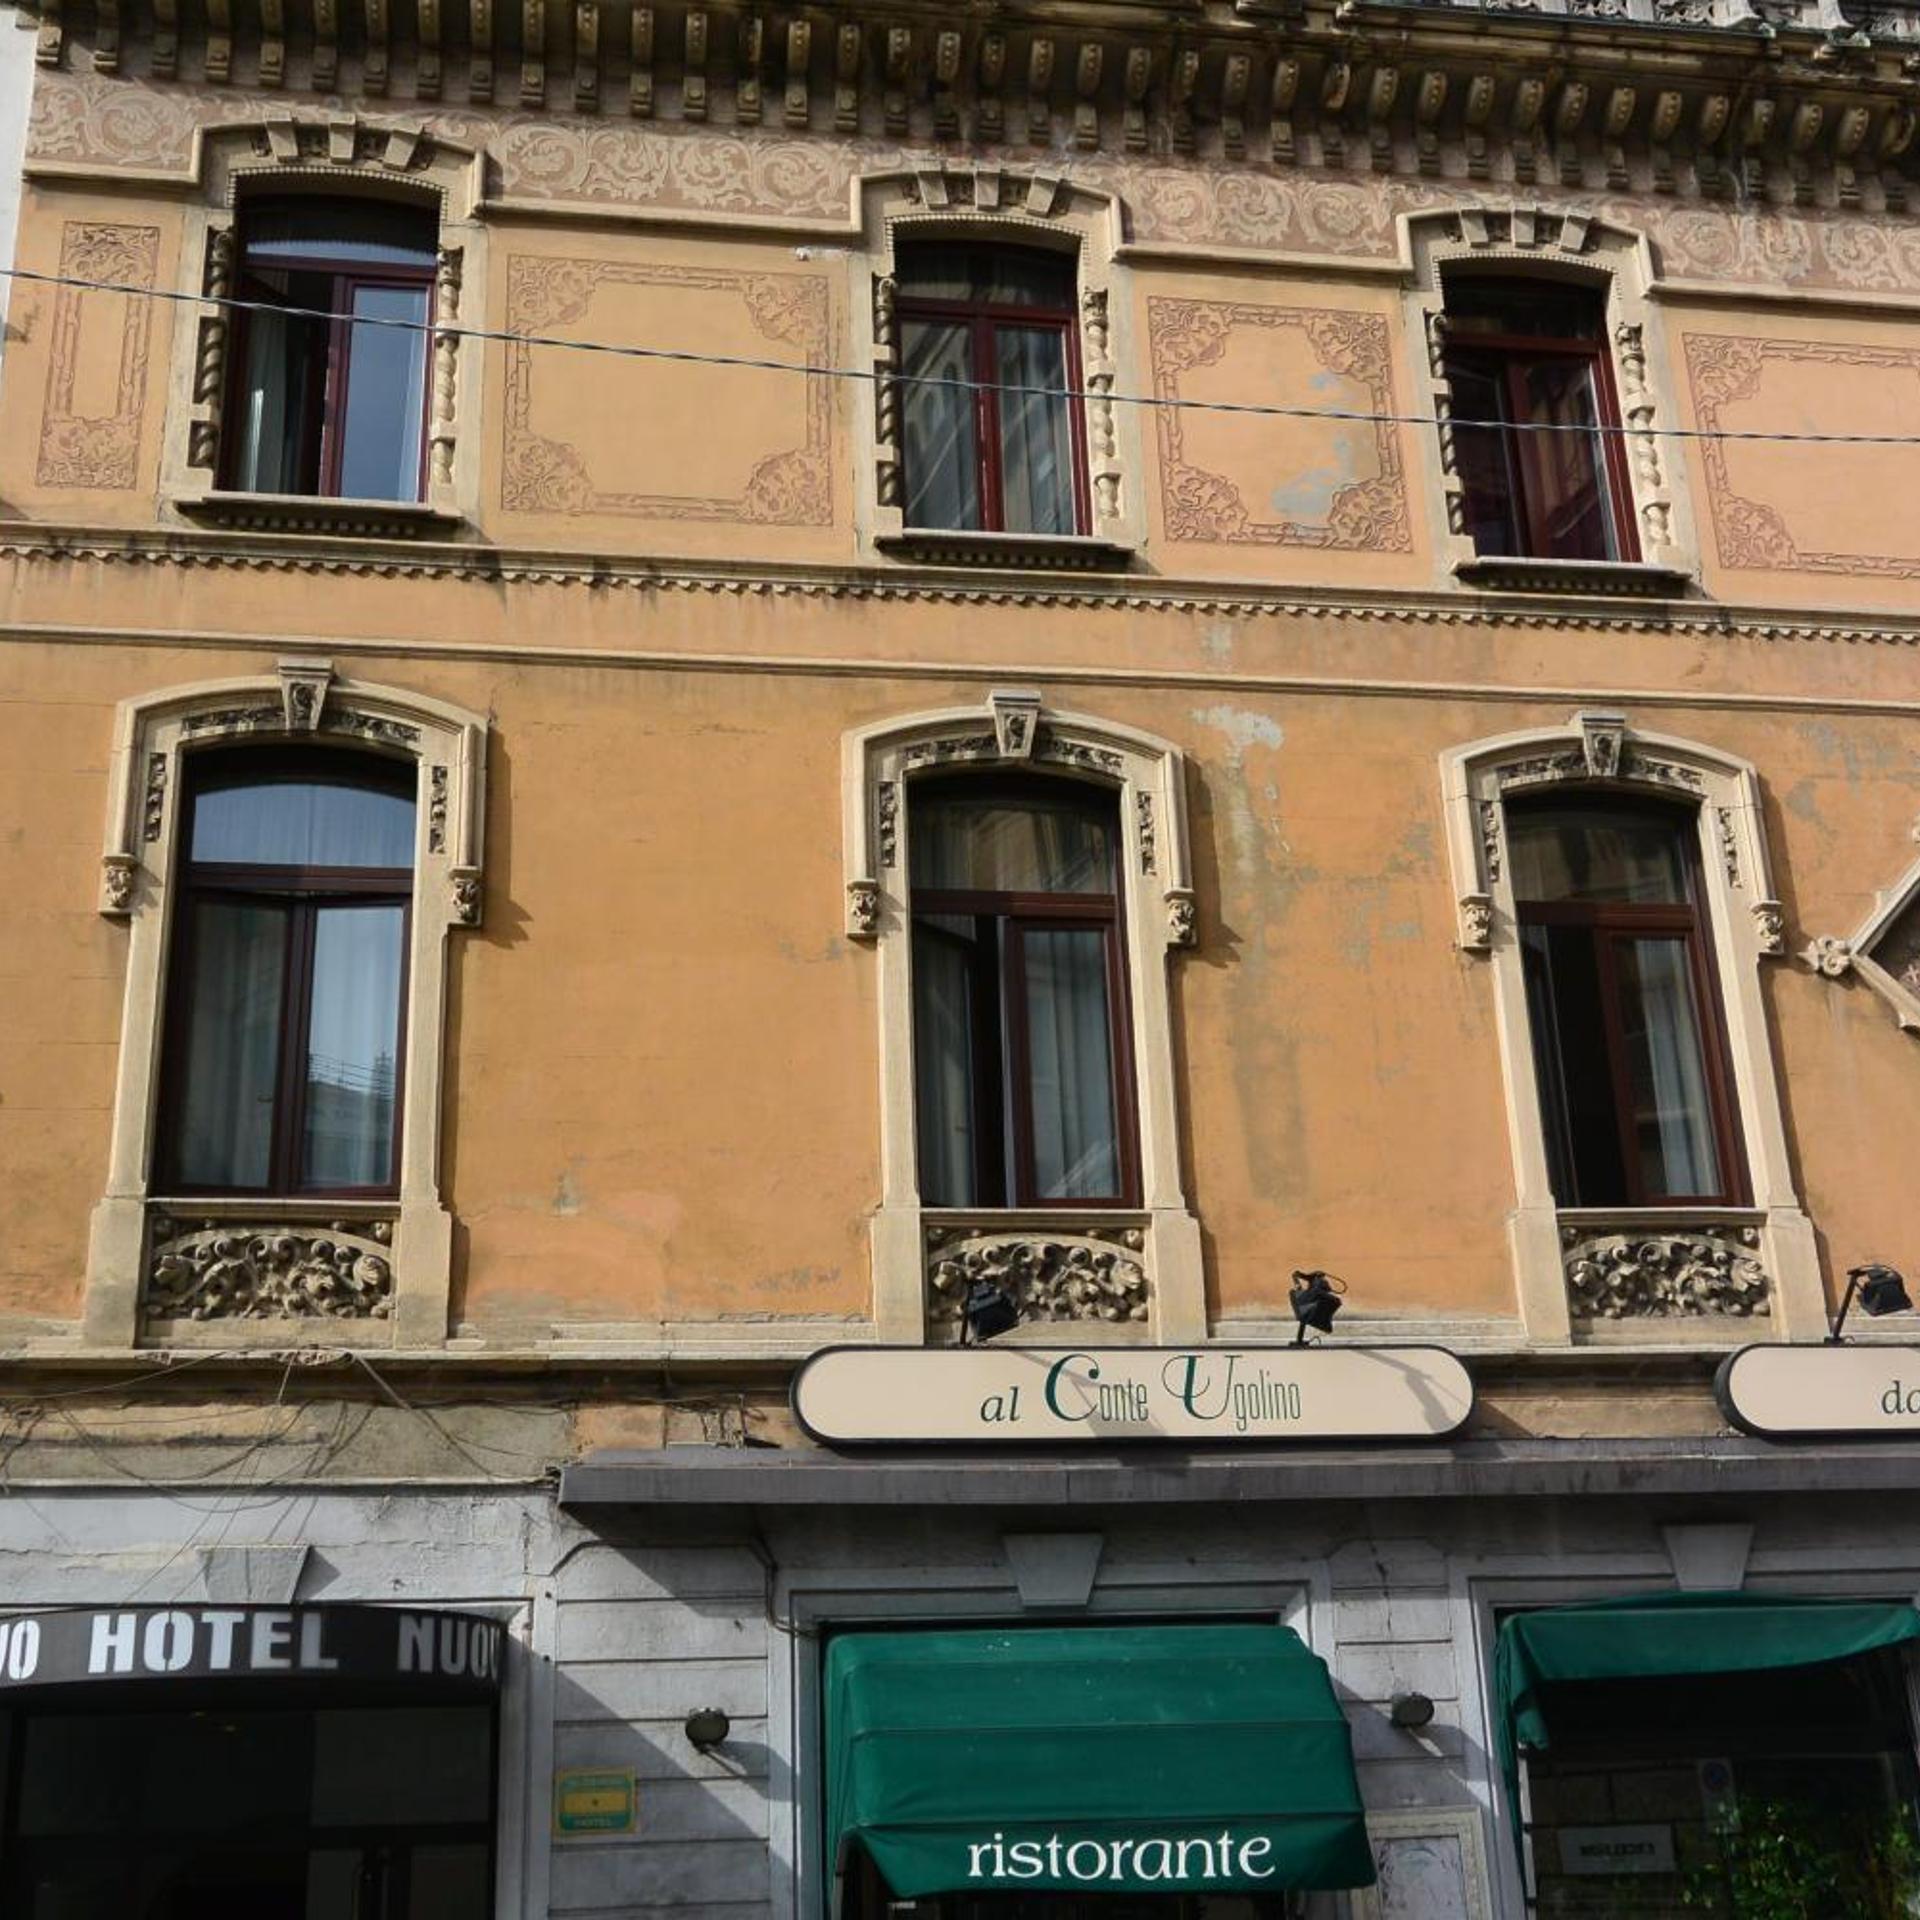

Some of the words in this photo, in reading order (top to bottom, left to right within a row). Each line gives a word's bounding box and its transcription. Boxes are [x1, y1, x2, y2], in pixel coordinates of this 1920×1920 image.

[980, 1386, 1020, 1422] al
[1045, 1353, 1149, 1422] Conte
[1161, 1354, 1300, 1432] Ugolino
[88, 1611, 339, 1674] HOTEL
[967, 1830, 1276, 1881] ristorante
